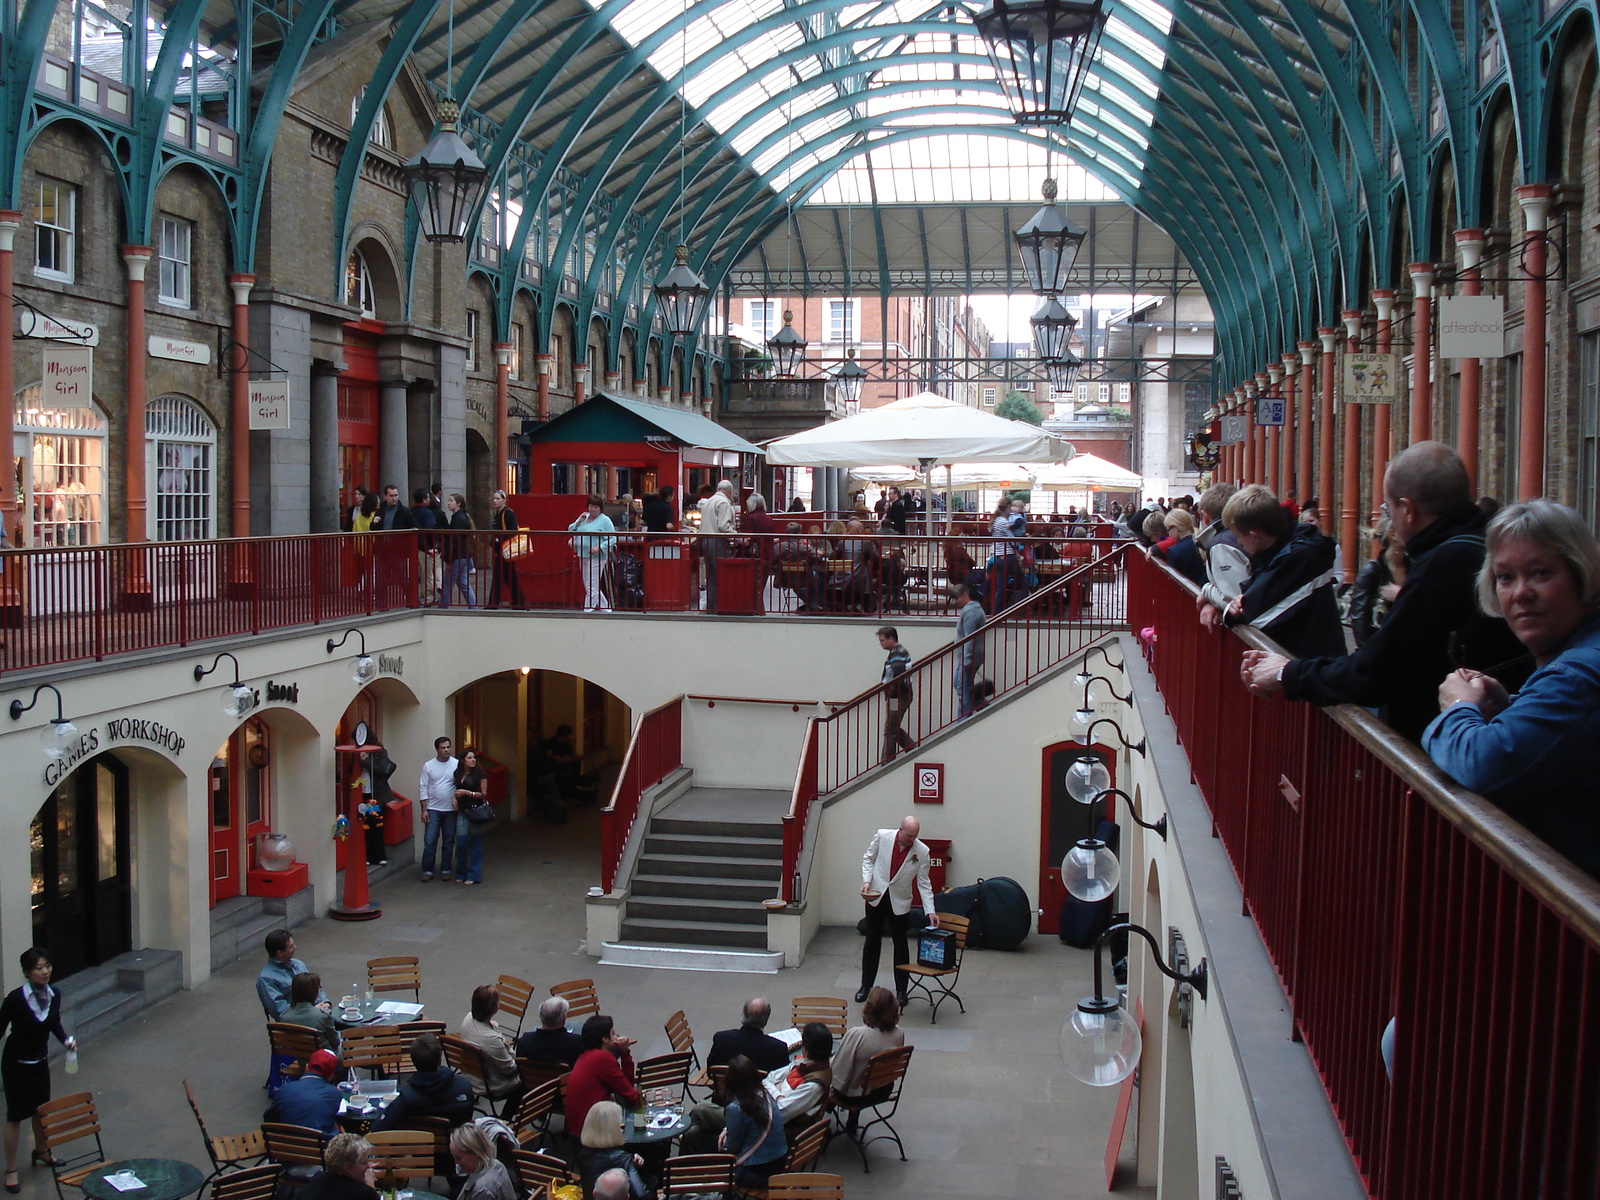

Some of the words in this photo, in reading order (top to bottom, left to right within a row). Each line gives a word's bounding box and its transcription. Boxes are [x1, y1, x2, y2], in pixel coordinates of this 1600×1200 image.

[1441, 321, 1502, 334] aftershock
[184, 345, 195, 357] Girl
[47, 361, 88, 376] Monsoon
[55, 381, 78, 395] Girl
[251, 392, 286, 404] Monsoon
[258, 407, 278, 418] Girl
[267, 680, 299, 703] Snook
[43, 727, 99, 786] GAMES
[107, 717, 186, 756] WORKSHOP
